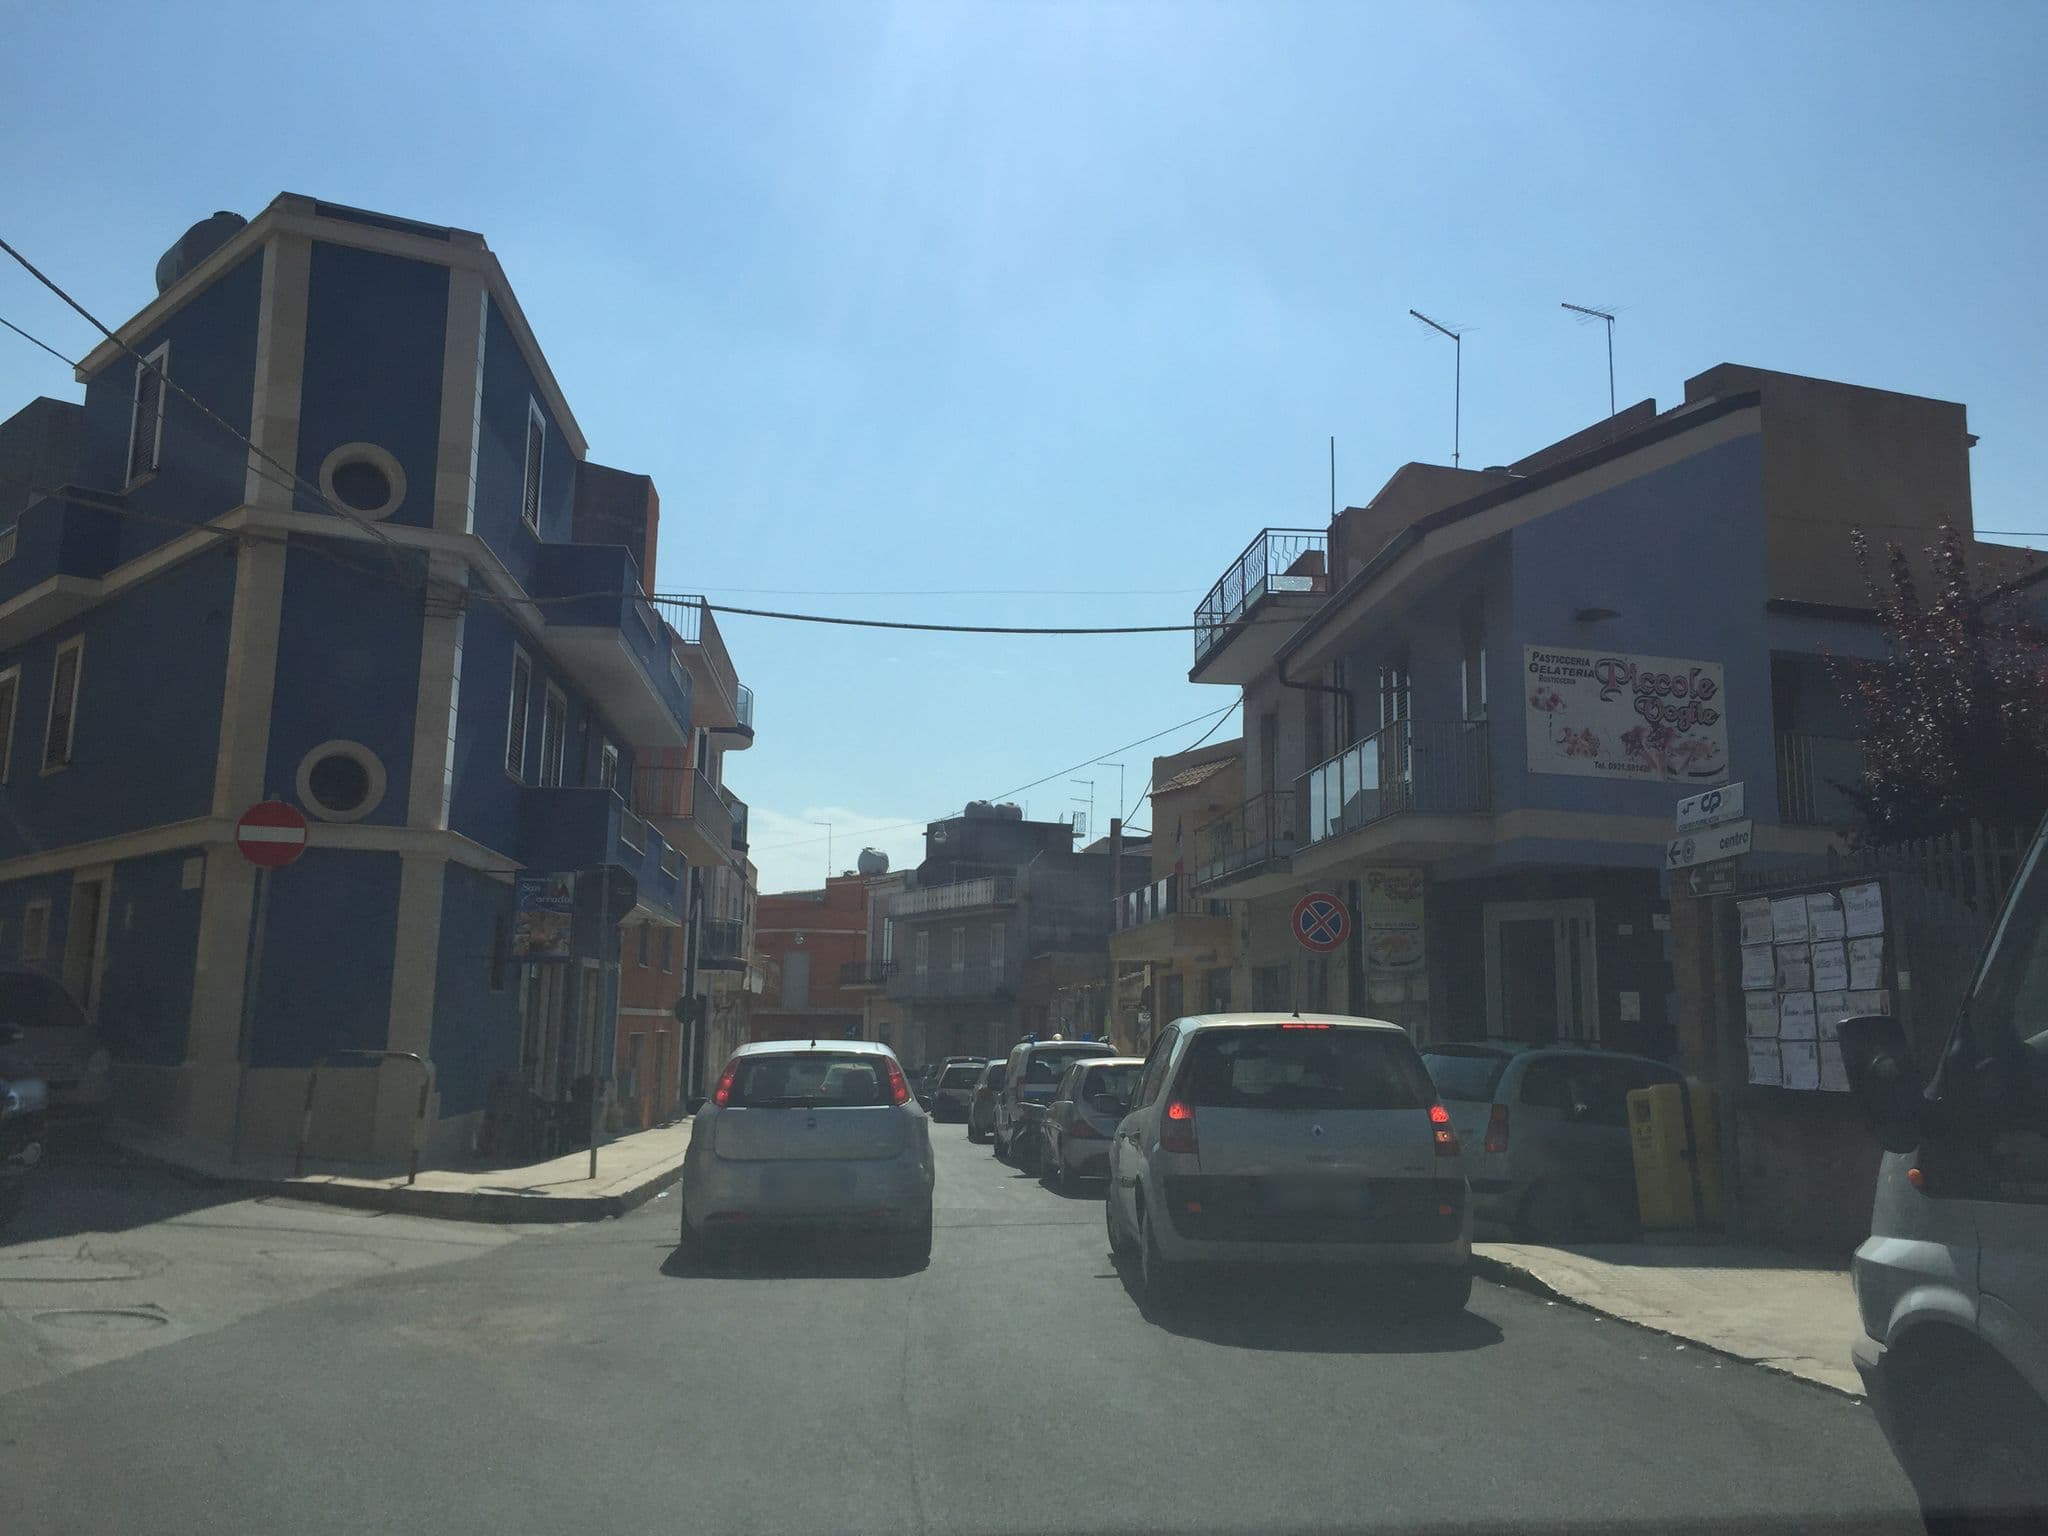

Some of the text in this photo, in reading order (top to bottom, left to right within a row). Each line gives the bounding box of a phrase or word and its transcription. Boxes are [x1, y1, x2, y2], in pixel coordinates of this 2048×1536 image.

[1532, 651, 1591, 667] PASTICCERIA
[1529, 662, 1595, 678] GELATERIA
[1594, 657, 1719, 702] Piccole
[1719, 831, 1749, 850] centro
[522, 882, 541, 892] San
